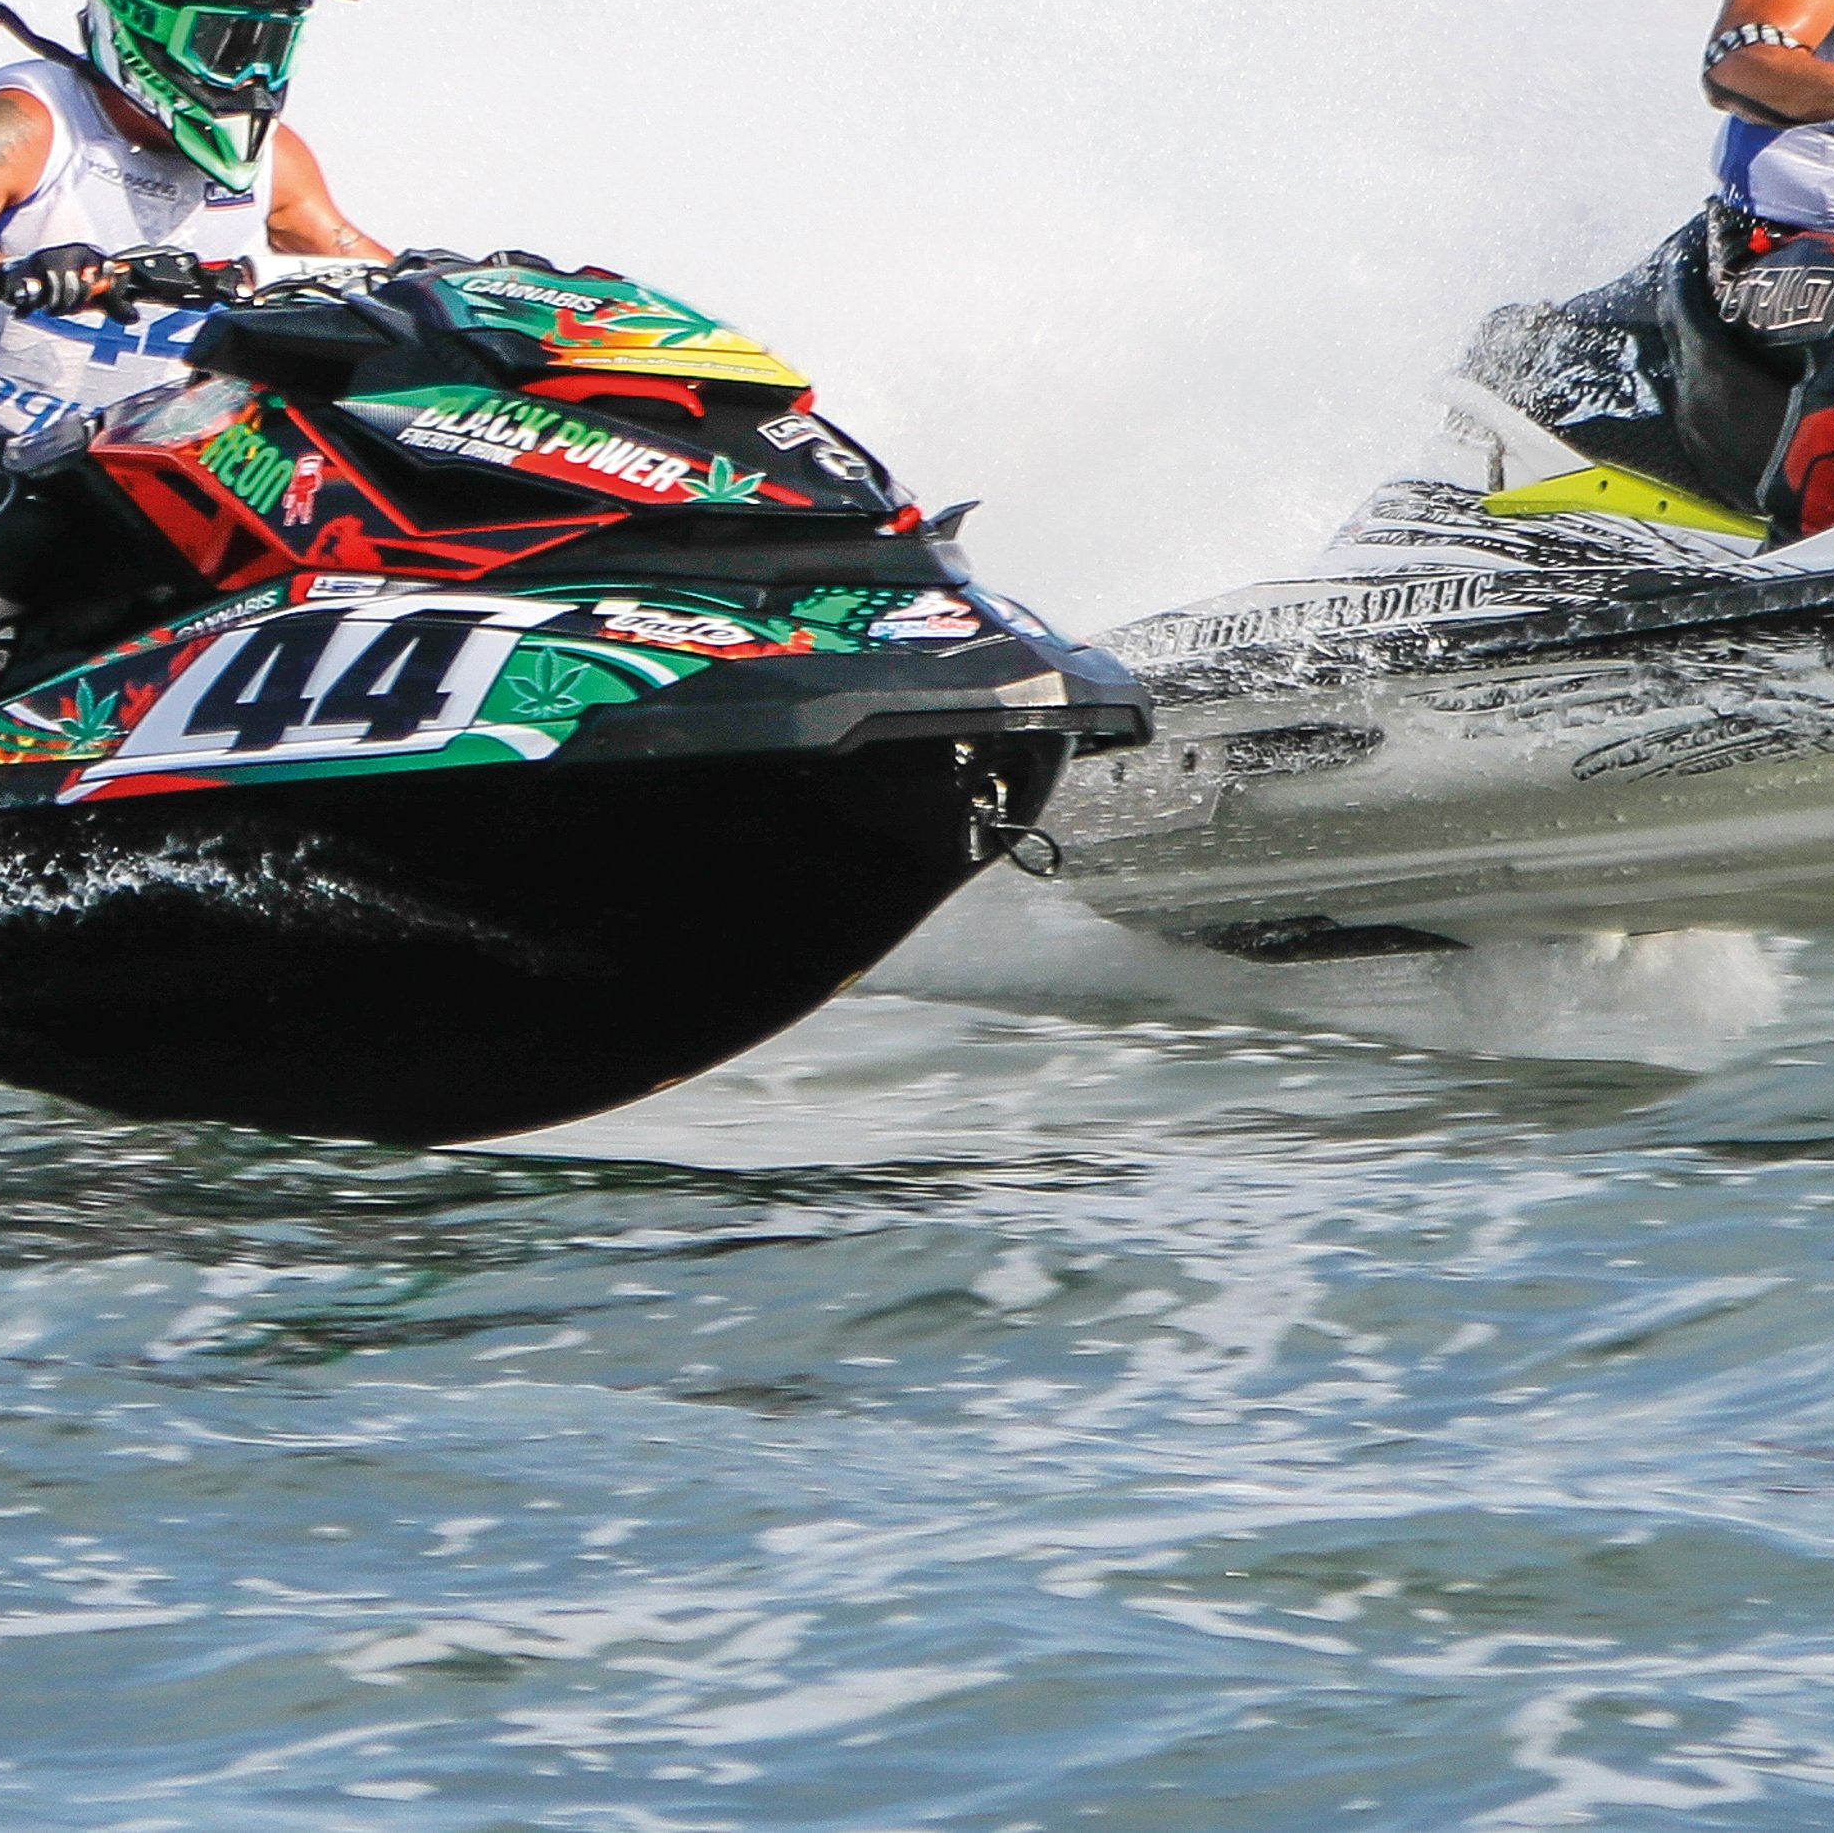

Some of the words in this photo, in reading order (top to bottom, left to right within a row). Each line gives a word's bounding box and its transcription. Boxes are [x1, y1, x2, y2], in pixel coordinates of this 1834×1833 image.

[462, 277, 603, 313] CANNABIS
[412, 398, 562, 451] BLACK
[539, 420, 691, 492] POWER
[182, 608, 474, 752] 44
